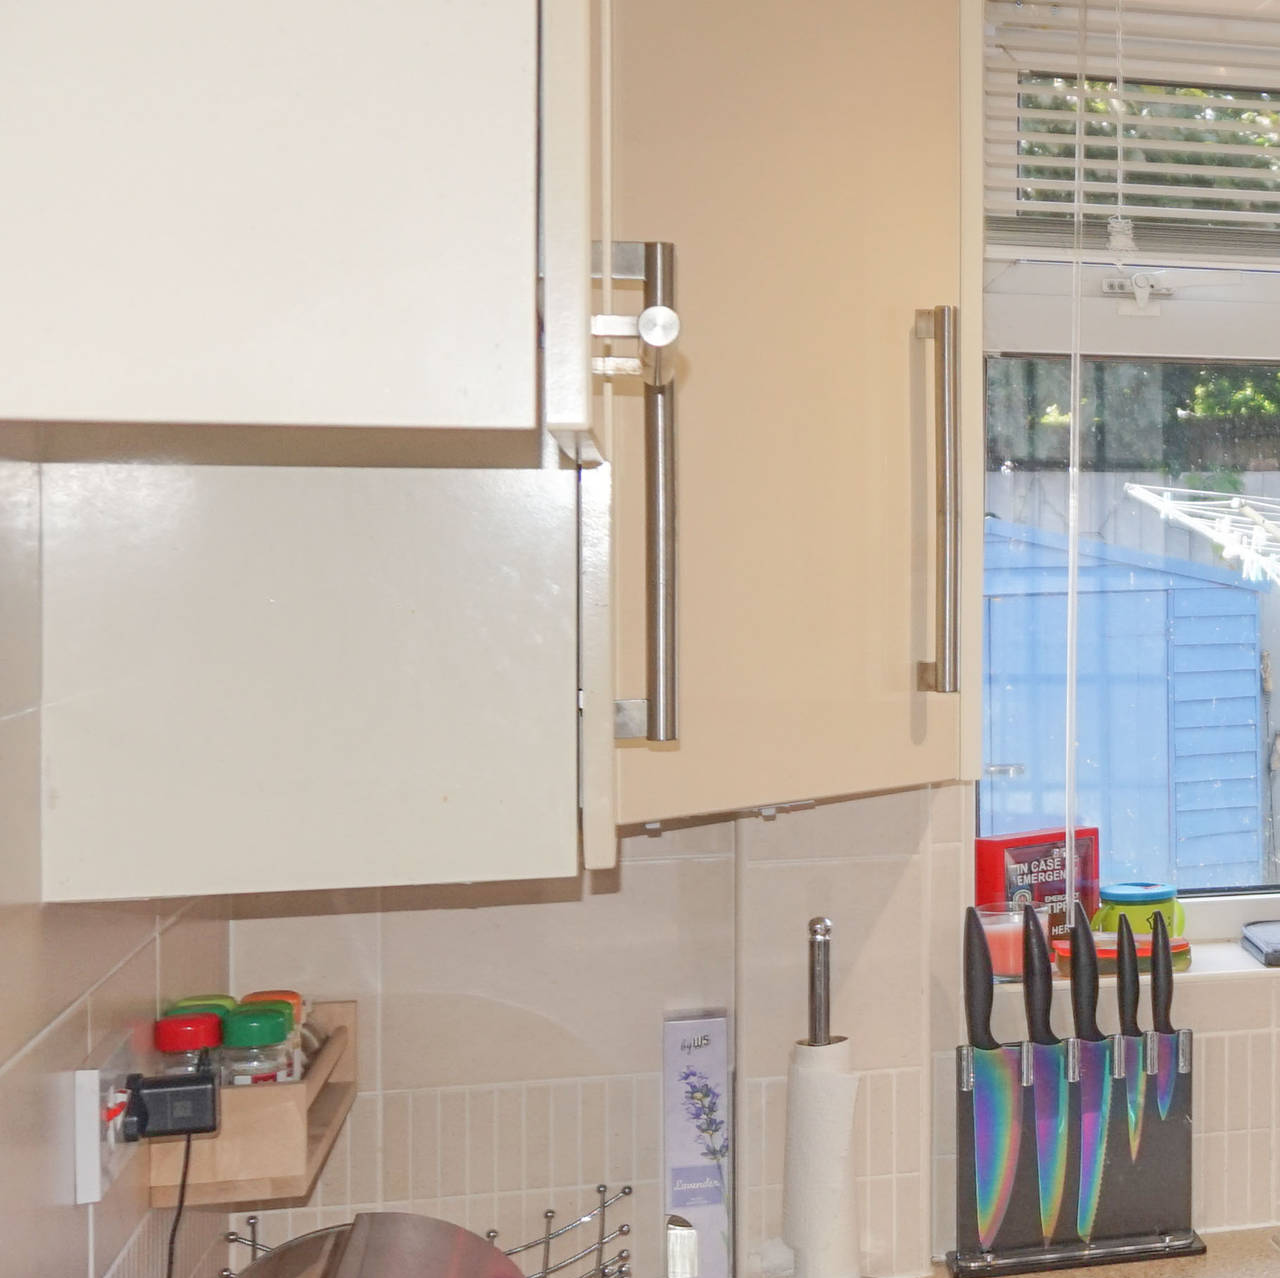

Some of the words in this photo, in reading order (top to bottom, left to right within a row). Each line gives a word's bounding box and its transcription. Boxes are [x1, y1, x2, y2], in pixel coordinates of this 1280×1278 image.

[1016, 863, 1028, 873] IN
[1031, 858, 1062, 872] CASE
[1017, 870, 1067, 885] EMERGEN
